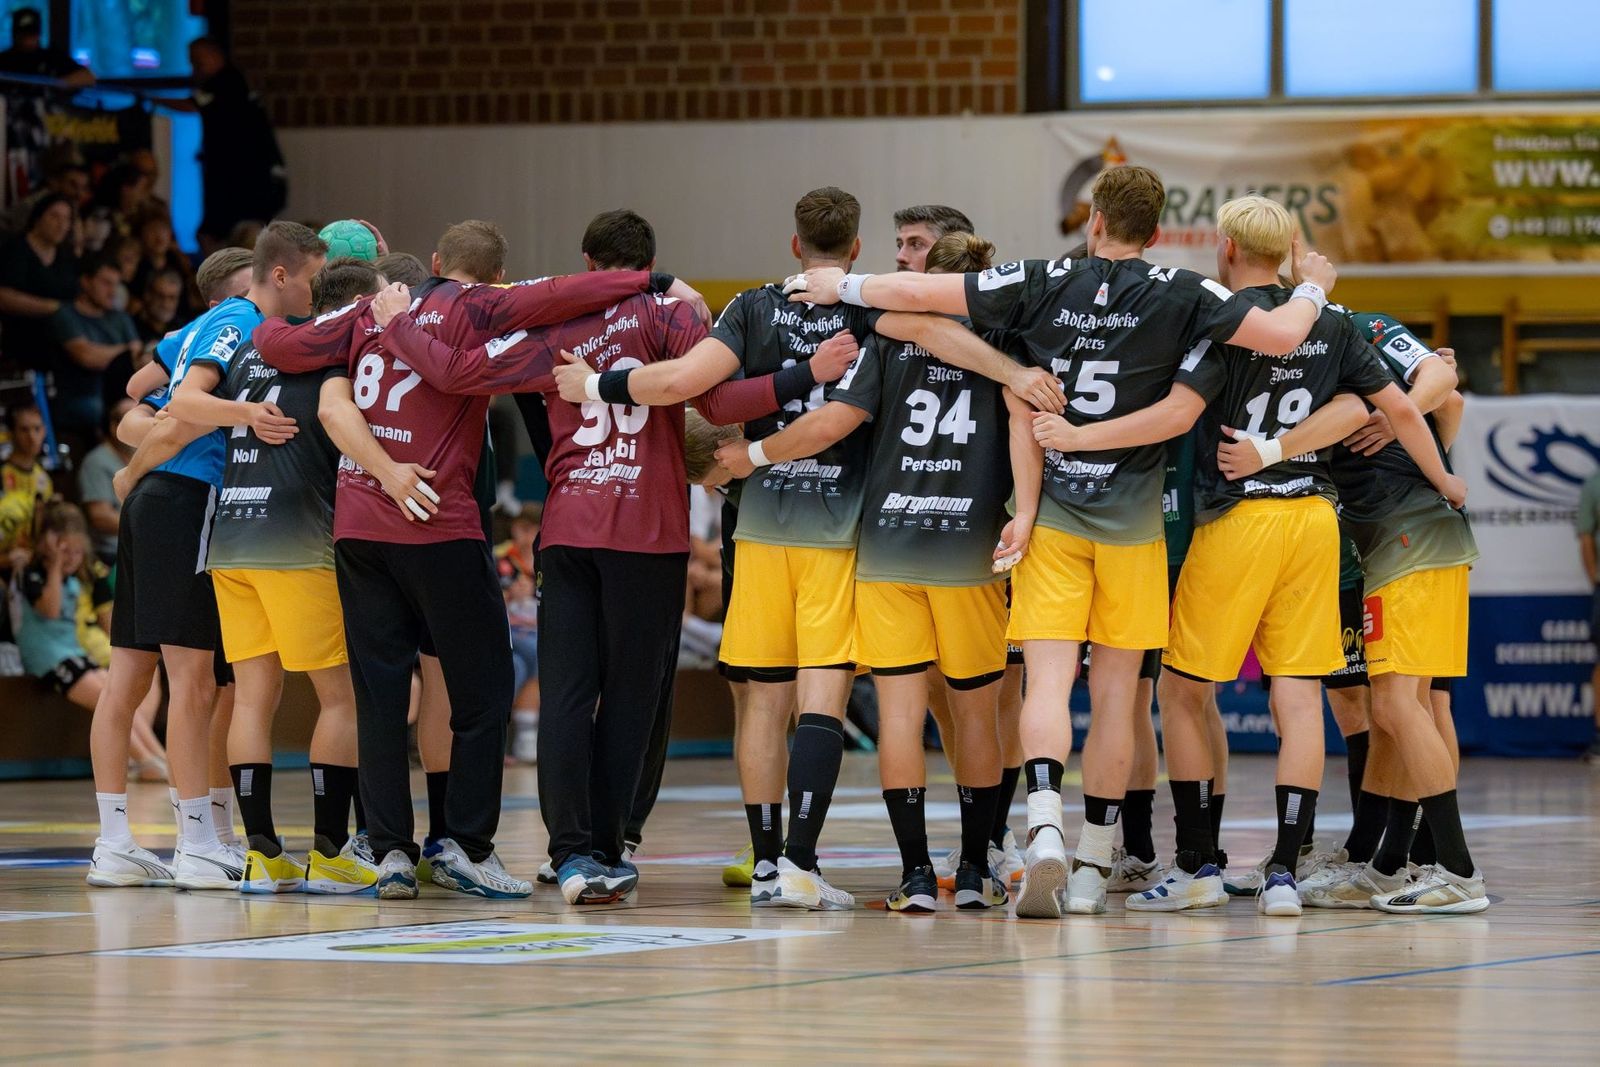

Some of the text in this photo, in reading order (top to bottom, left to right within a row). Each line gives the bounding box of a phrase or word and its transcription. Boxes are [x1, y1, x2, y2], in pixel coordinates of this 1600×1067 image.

[354, 354, 422, 412] 87
[901, 389, 977, 447] 34
[1245, 387, 1313, 440] 19
[368, 423, 412, 444] mann
[233, 449, 258, 464] Noll
[901, 456, 962, 472] Persson
